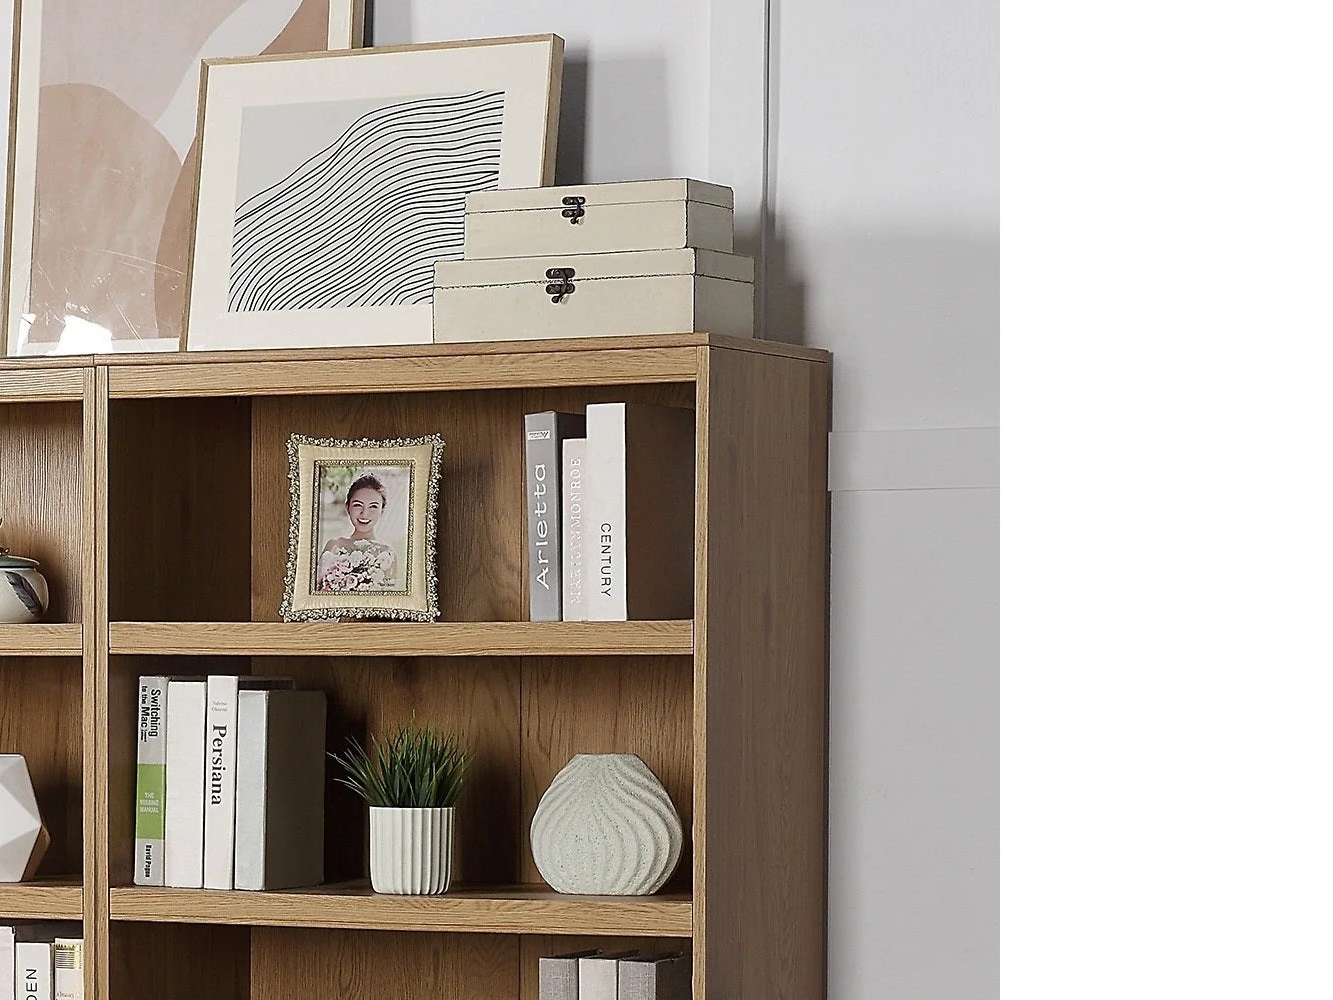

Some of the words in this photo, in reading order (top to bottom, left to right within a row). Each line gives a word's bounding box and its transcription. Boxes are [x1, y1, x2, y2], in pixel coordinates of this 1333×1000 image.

[601, 522, 612, 597] CENTURY
[141, 706, 150, 728] Mac
[149, 689, 162, 737] Switching
[210, 724, 228, 805] Persiana
